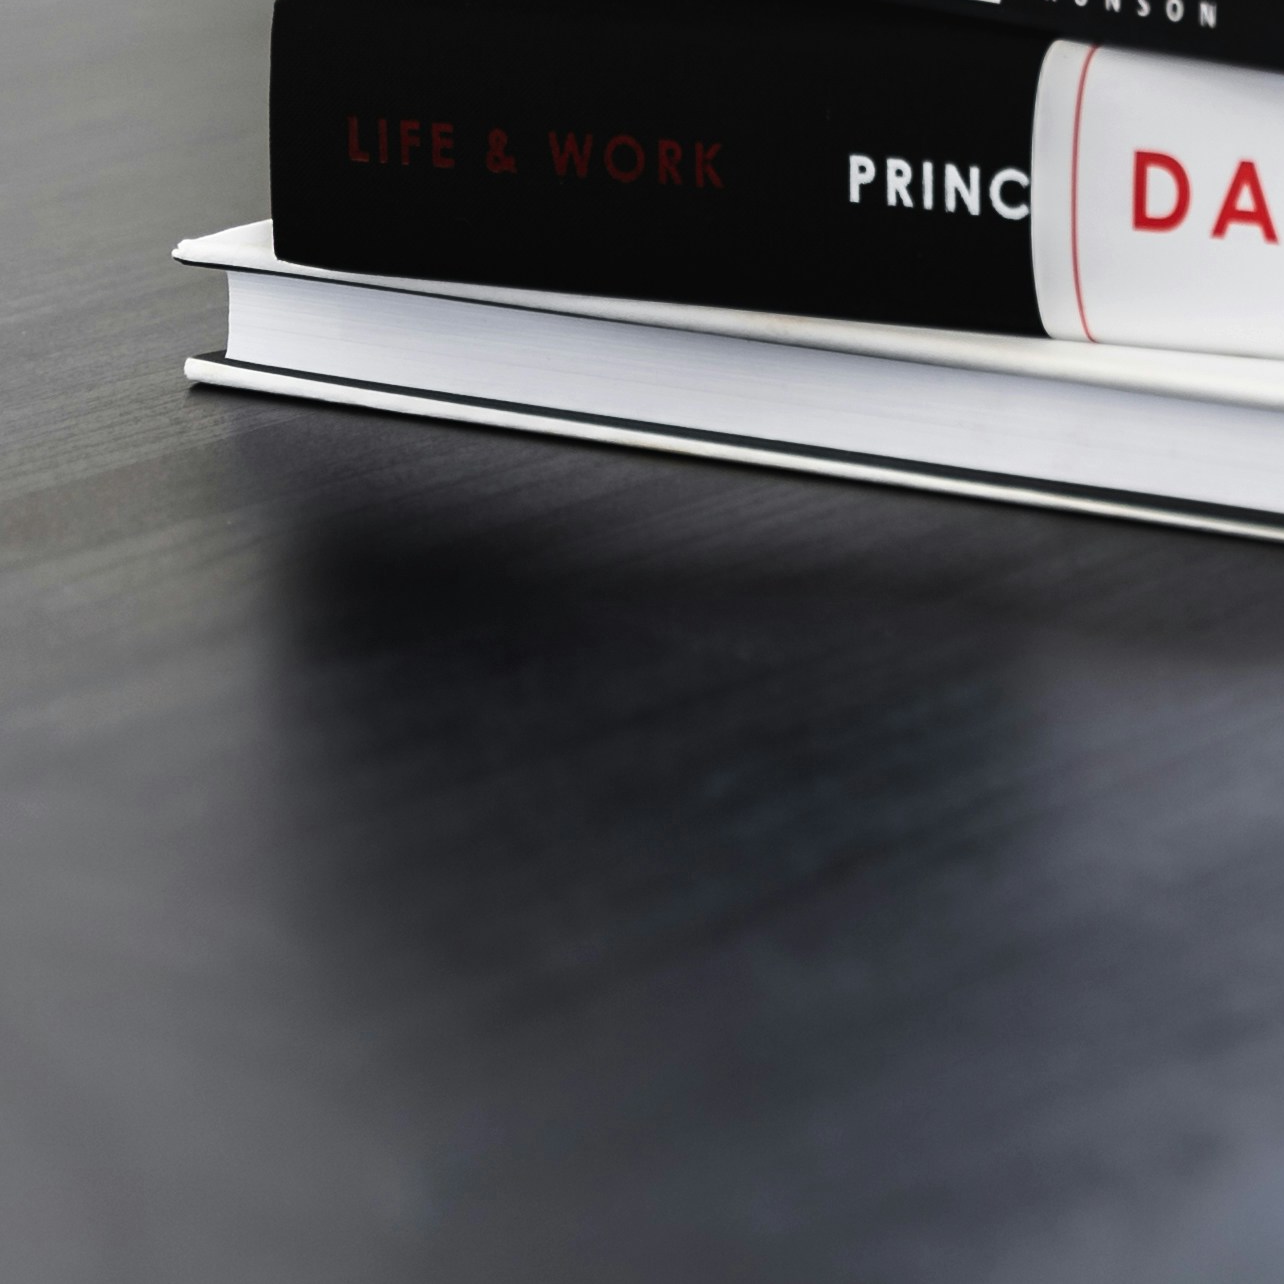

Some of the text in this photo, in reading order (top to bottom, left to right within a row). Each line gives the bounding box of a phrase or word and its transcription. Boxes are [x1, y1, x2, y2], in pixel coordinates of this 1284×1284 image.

[348, 114, 724, 190] LIFE & WORK
[848, 153, 1031, 221] PRINC
